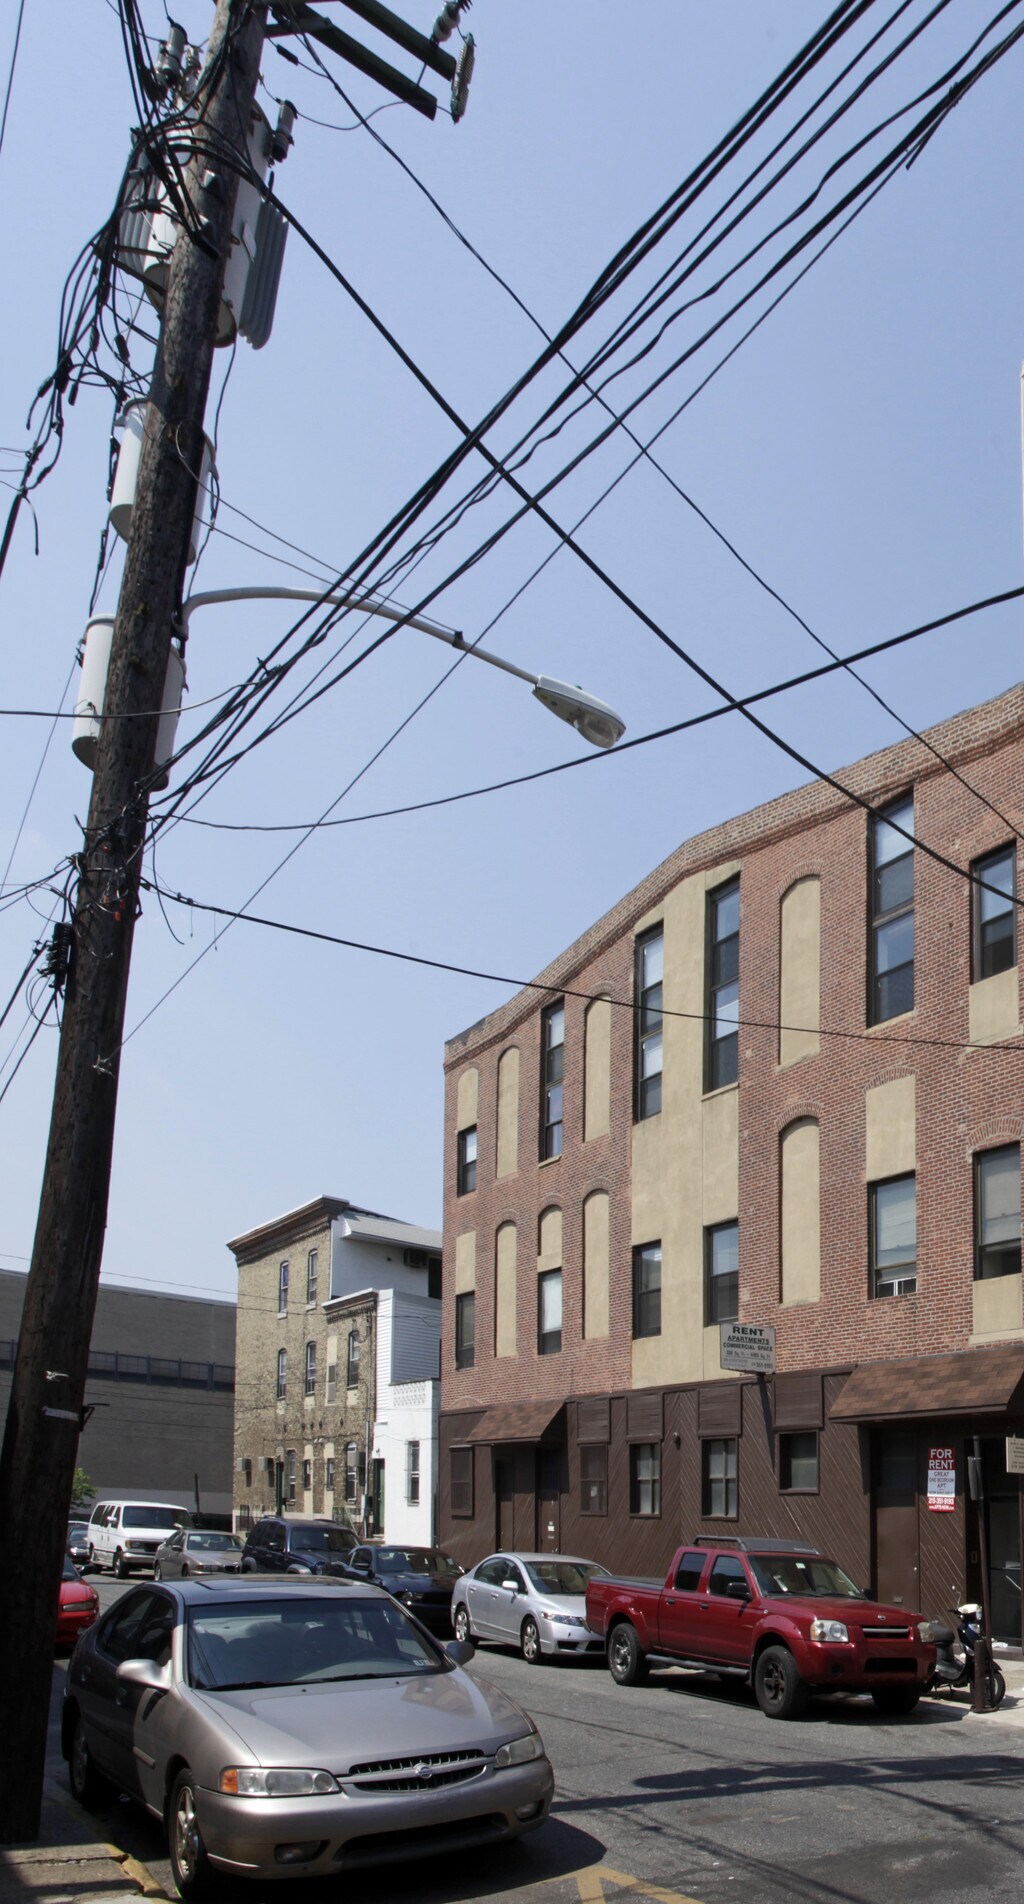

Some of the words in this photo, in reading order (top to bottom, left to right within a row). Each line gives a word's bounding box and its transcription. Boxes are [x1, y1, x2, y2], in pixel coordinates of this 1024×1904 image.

[733, 1326, 764, 1336] RENT
[727, 1335, 770, 1345] APARTMENTS
[723, 1342, 755, 1350] COMMERCIAL
[930, 1449, 952, 1459] FOR
[929, 1460, 954, 1470] RENT
